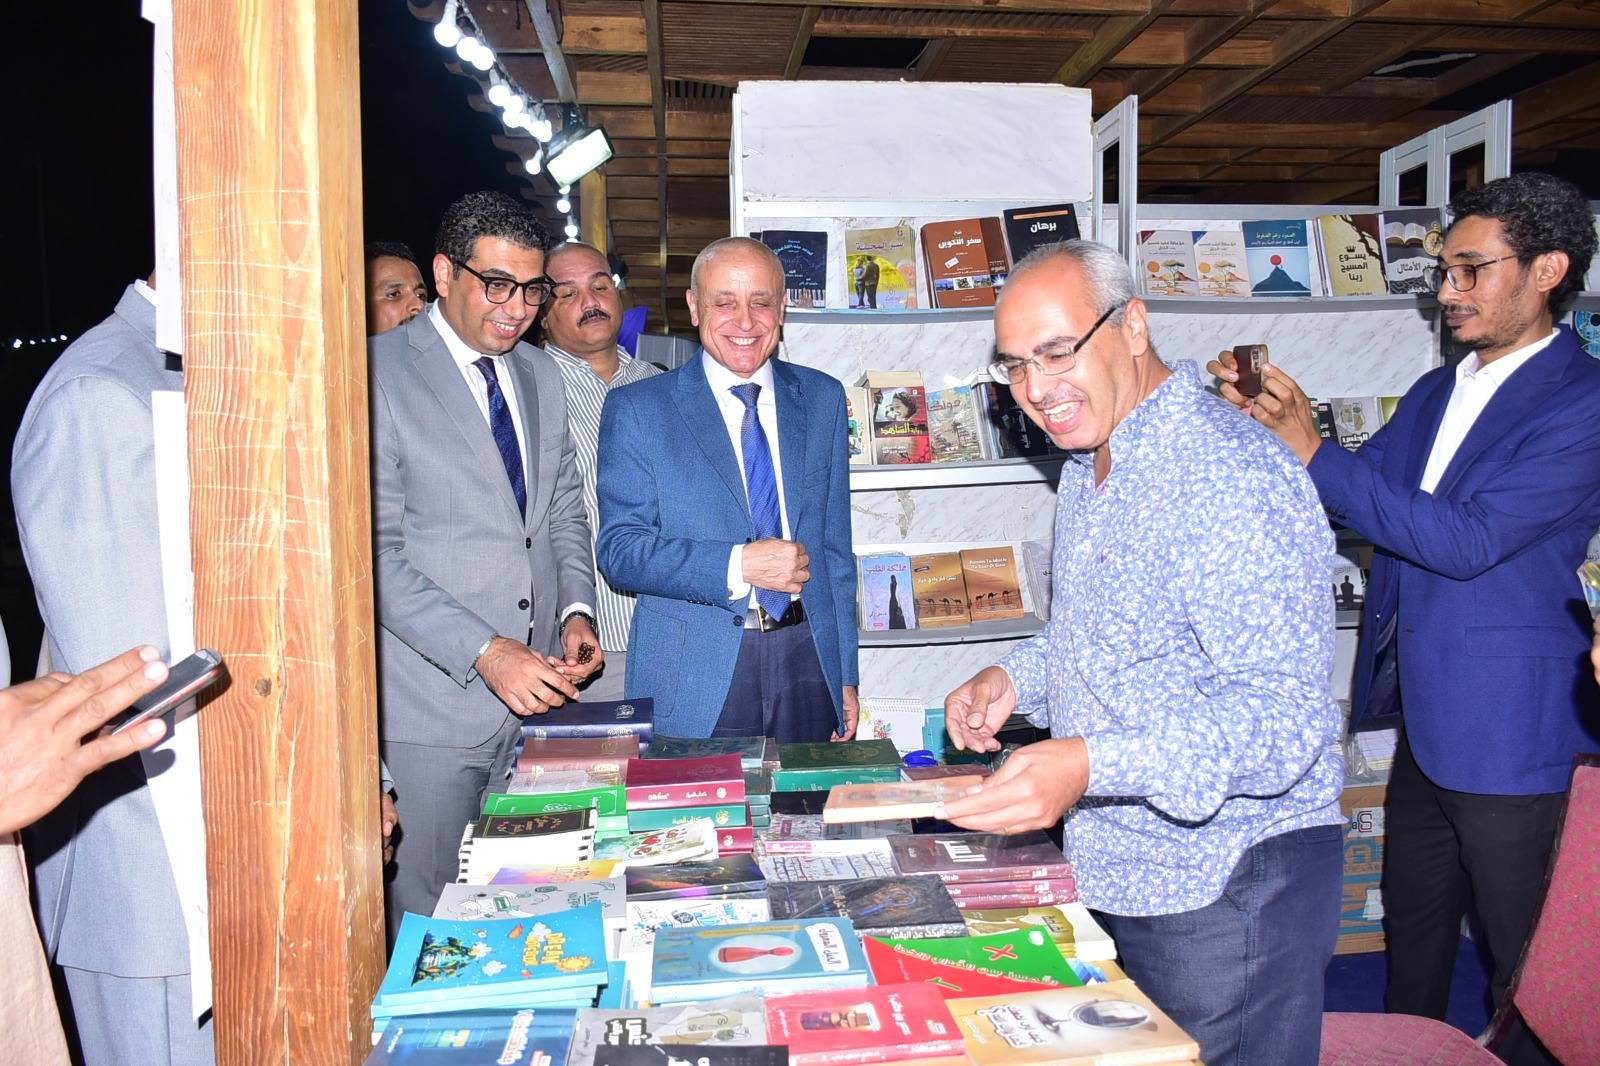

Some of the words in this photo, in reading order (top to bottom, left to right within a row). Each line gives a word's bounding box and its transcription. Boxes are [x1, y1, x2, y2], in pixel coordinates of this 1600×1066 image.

[1030, 221, 1057, 233] برهان
[1338, 253, 1367, 263] يسوع
[1340, 262, 1369, 273] المسيح
[1396, 261, 1421, 274] الأمثال
[1348, 273, 1363, 282] ربنا
[886, 563, 907, 573] مملكة
